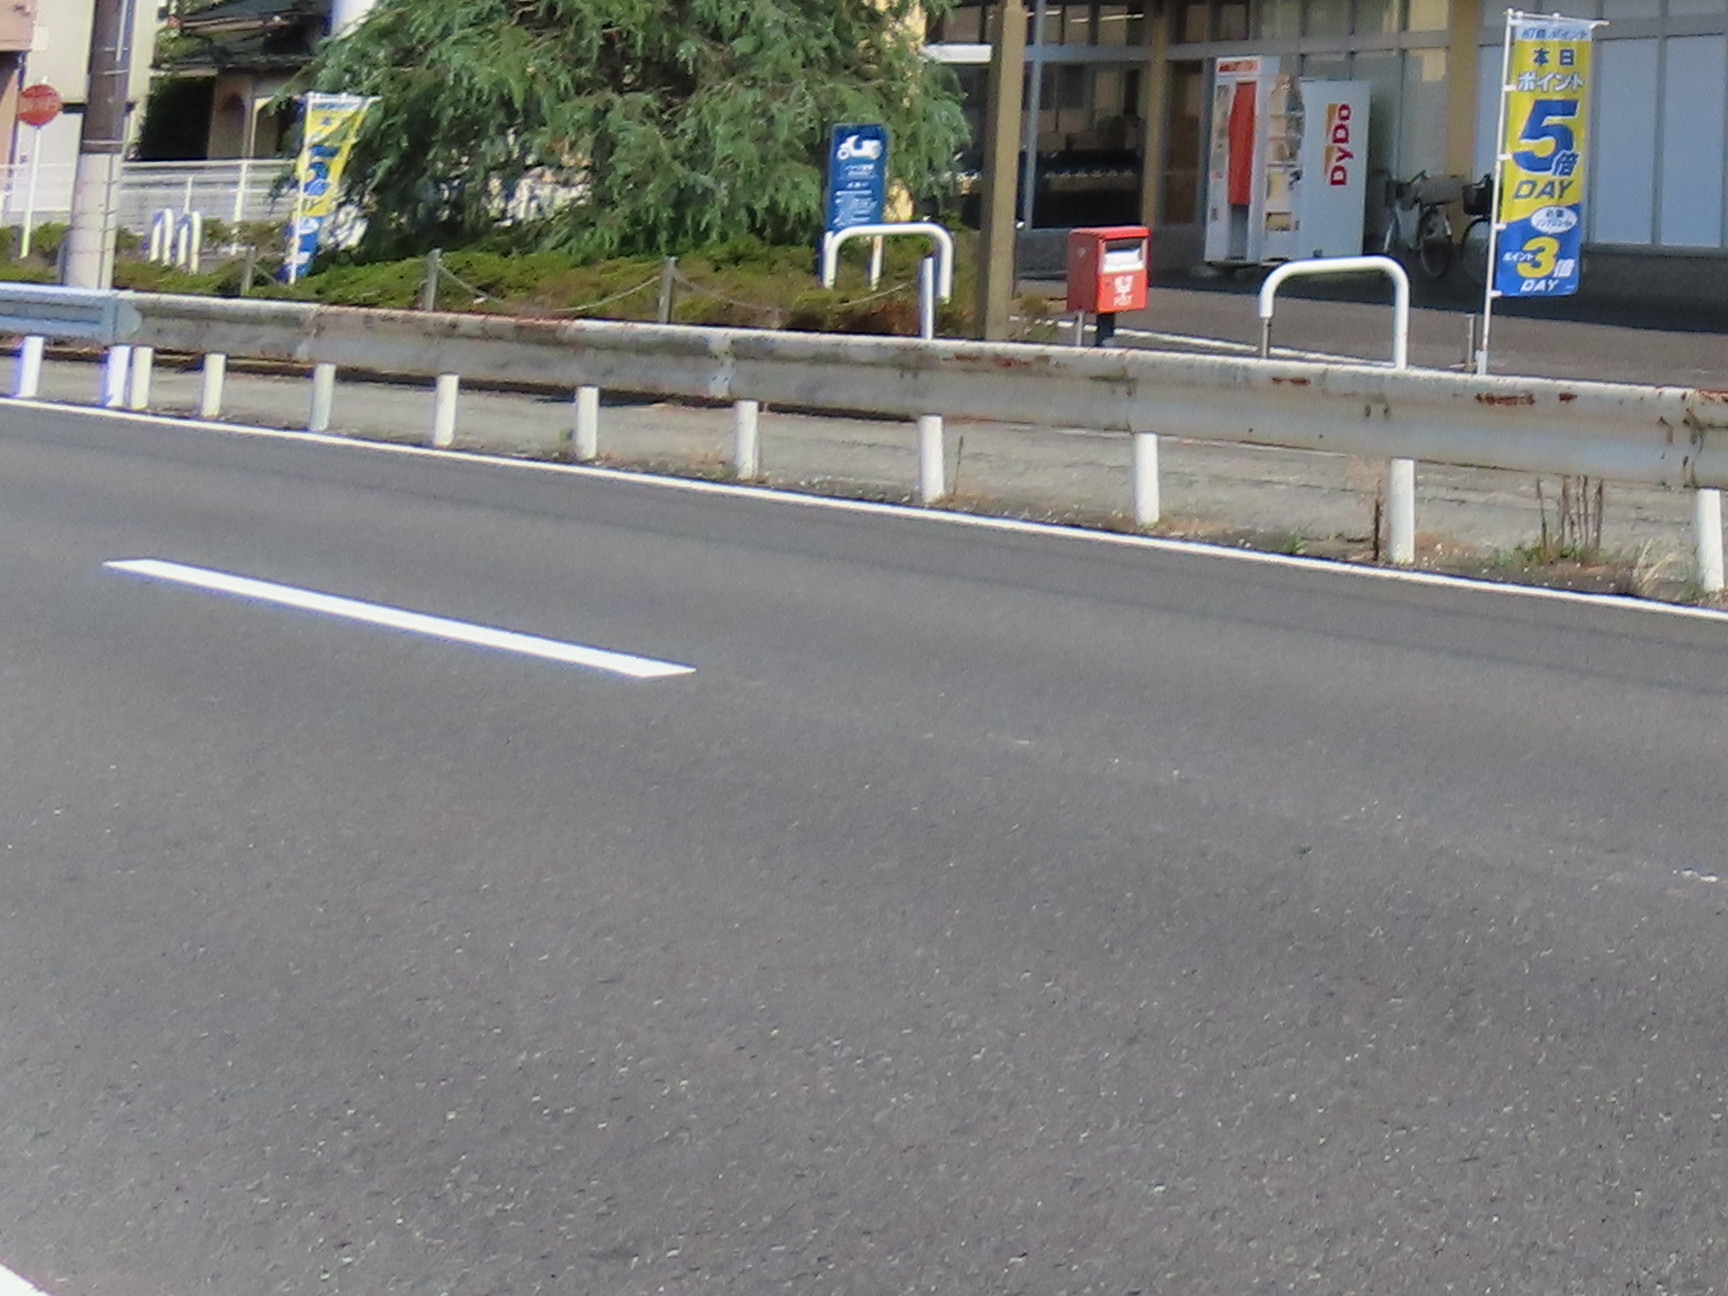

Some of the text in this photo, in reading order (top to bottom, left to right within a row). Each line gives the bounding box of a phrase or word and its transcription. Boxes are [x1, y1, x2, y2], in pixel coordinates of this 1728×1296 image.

[1533, 47, 1576, 67] 本日
[1517, 71, 1584, 93] ポイント
[1513, 179, 1574, 200] DAY
[1520, 279, 1560, 292] DAY
